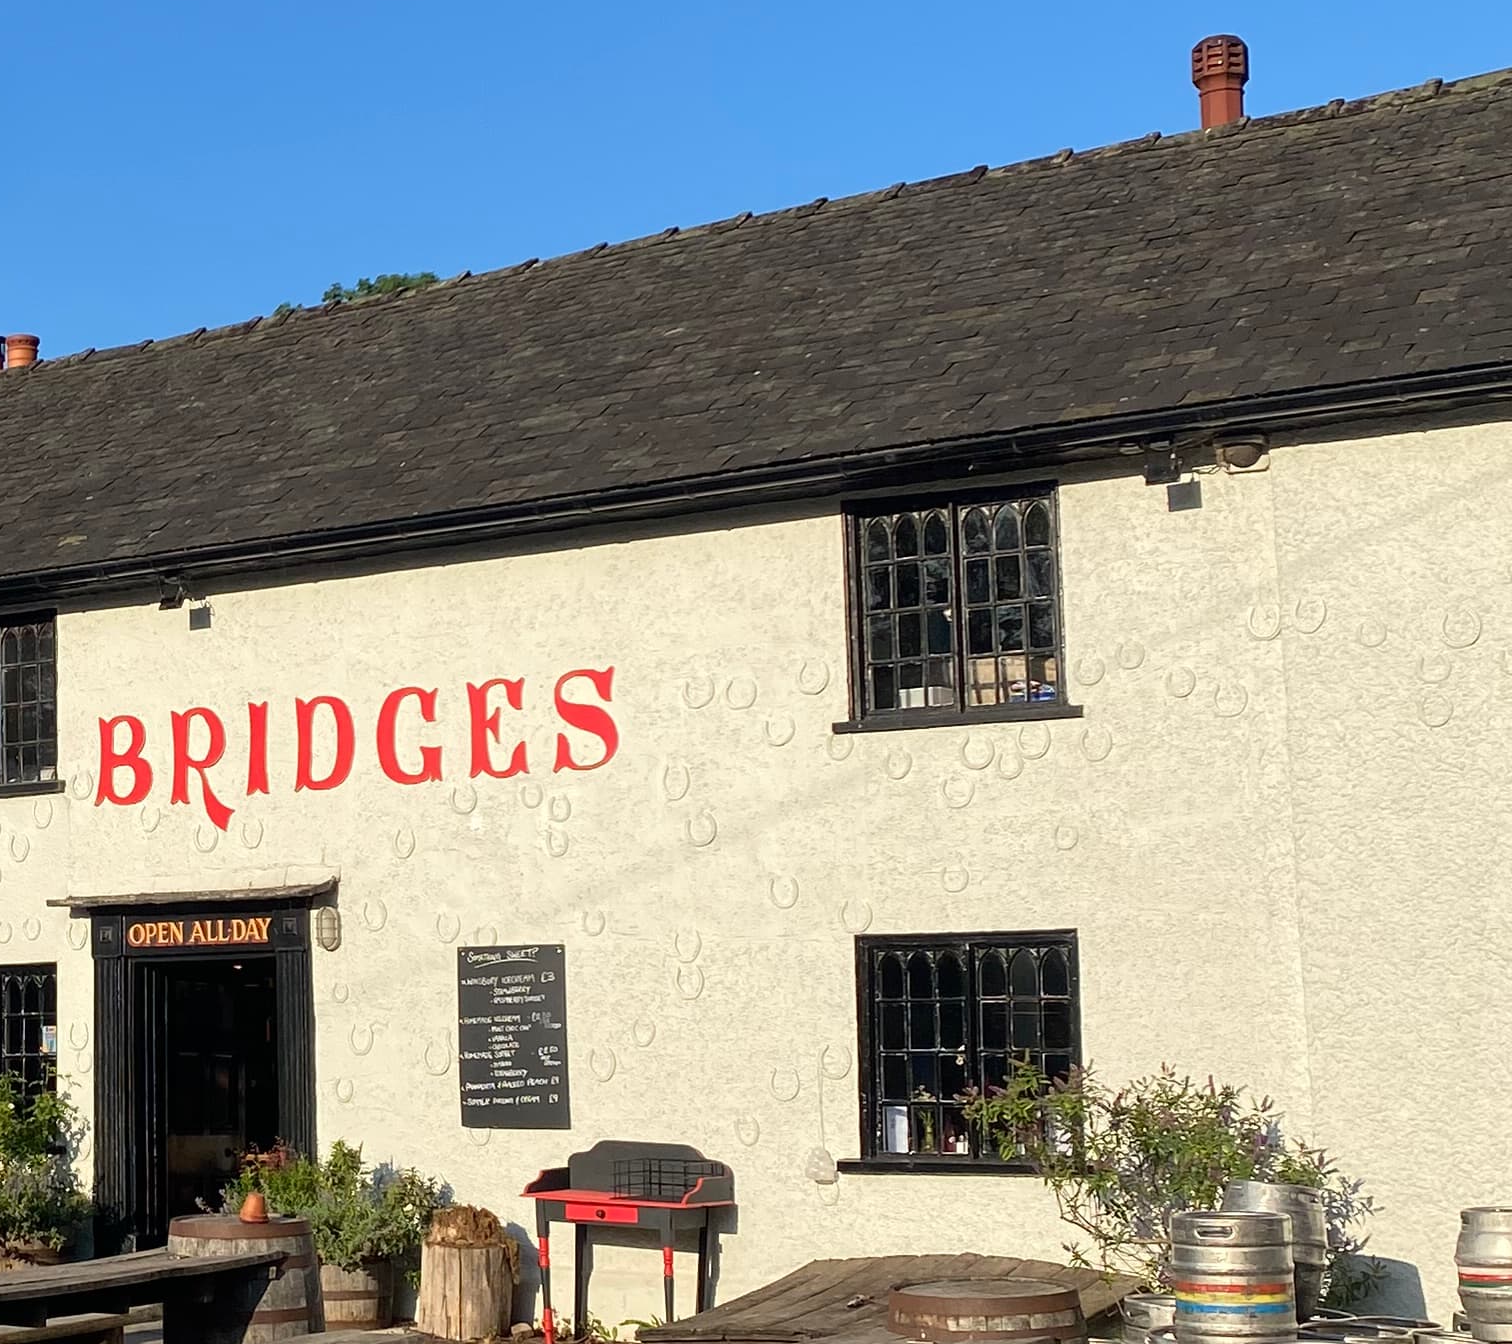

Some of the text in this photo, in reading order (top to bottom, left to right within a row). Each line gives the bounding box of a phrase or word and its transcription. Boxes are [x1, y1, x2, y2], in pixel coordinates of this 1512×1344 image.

[94, 665, 619, 832] BRIDGES
[127, 921, 185, 947] OPEN
[506, 947, 539, 960] SWEET?
[541, 971, 555, 983] £3
